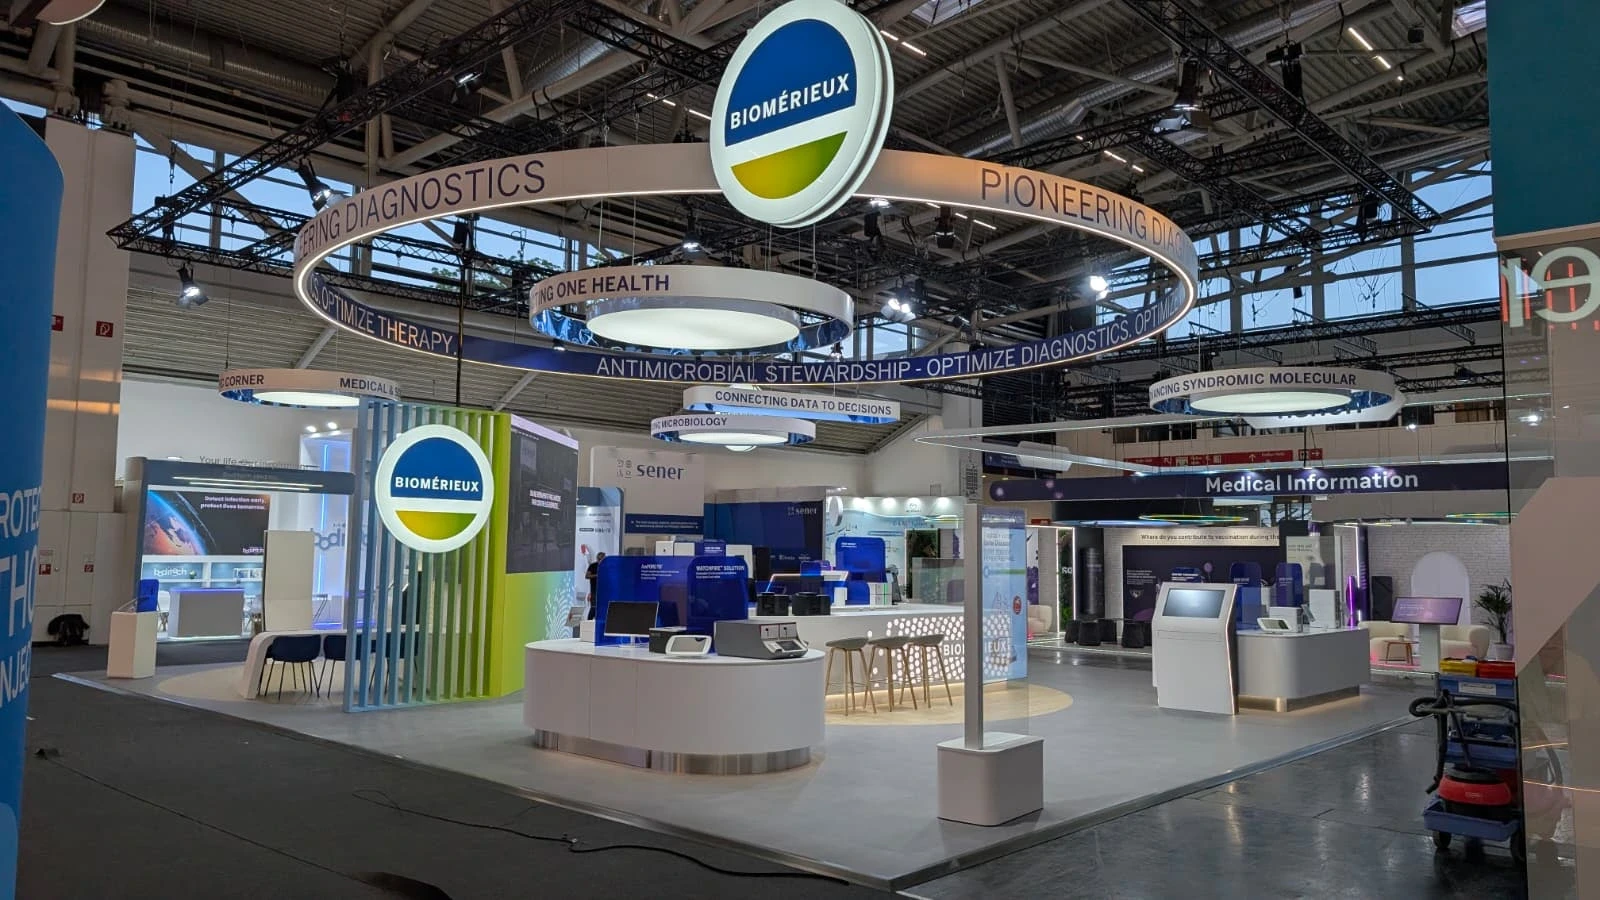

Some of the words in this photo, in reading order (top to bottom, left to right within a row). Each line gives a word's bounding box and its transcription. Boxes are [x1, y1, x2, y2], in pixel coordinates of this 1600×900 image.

[730, 73, 849, 130] BIOMÉRIEUX
[346, 160, 545, 232] DIAGNOSTICS
[982, 168, 1147, 240] PIONEERING
[557, 279, 587, 298] ONE
[592, 275, 669, 293] HEALTH
[322, 286, 375, 334] OPTIMIZE
[377, 315, 457, 356] THERAPY.
[597, 357, 757, 383] ANTIMICROBIAL
[766, 361, 911, 383] STEWARDSHIP
[927, 348, 1015, 377] OPTIMIZE
[1021, 320, 1131, 365] DIAGNOSTICS.
[225, 374, 264, 386] CORNER
[340, 377, 388, 394] MEDICAL
[1183, 373, 1264, 391] SYNDROMIC
[1270, 373, 1356, 385] MOLECULAR
[715, 390, 789, 406] CONNECTING
[791, 397, 819, 409] DATA
[822, 400, 835, 410] TO
[838, 403, 891, 415] DECISIONS
[661, 417, 727, 428] MICROBIOLOGY
[637, 463, 685, 480] sener
[1206, 476, 1280, 493] Medical
[1288, 472, 1418, 491] Information
[395, 476, 479, 492] BIOMÉRIEUX
